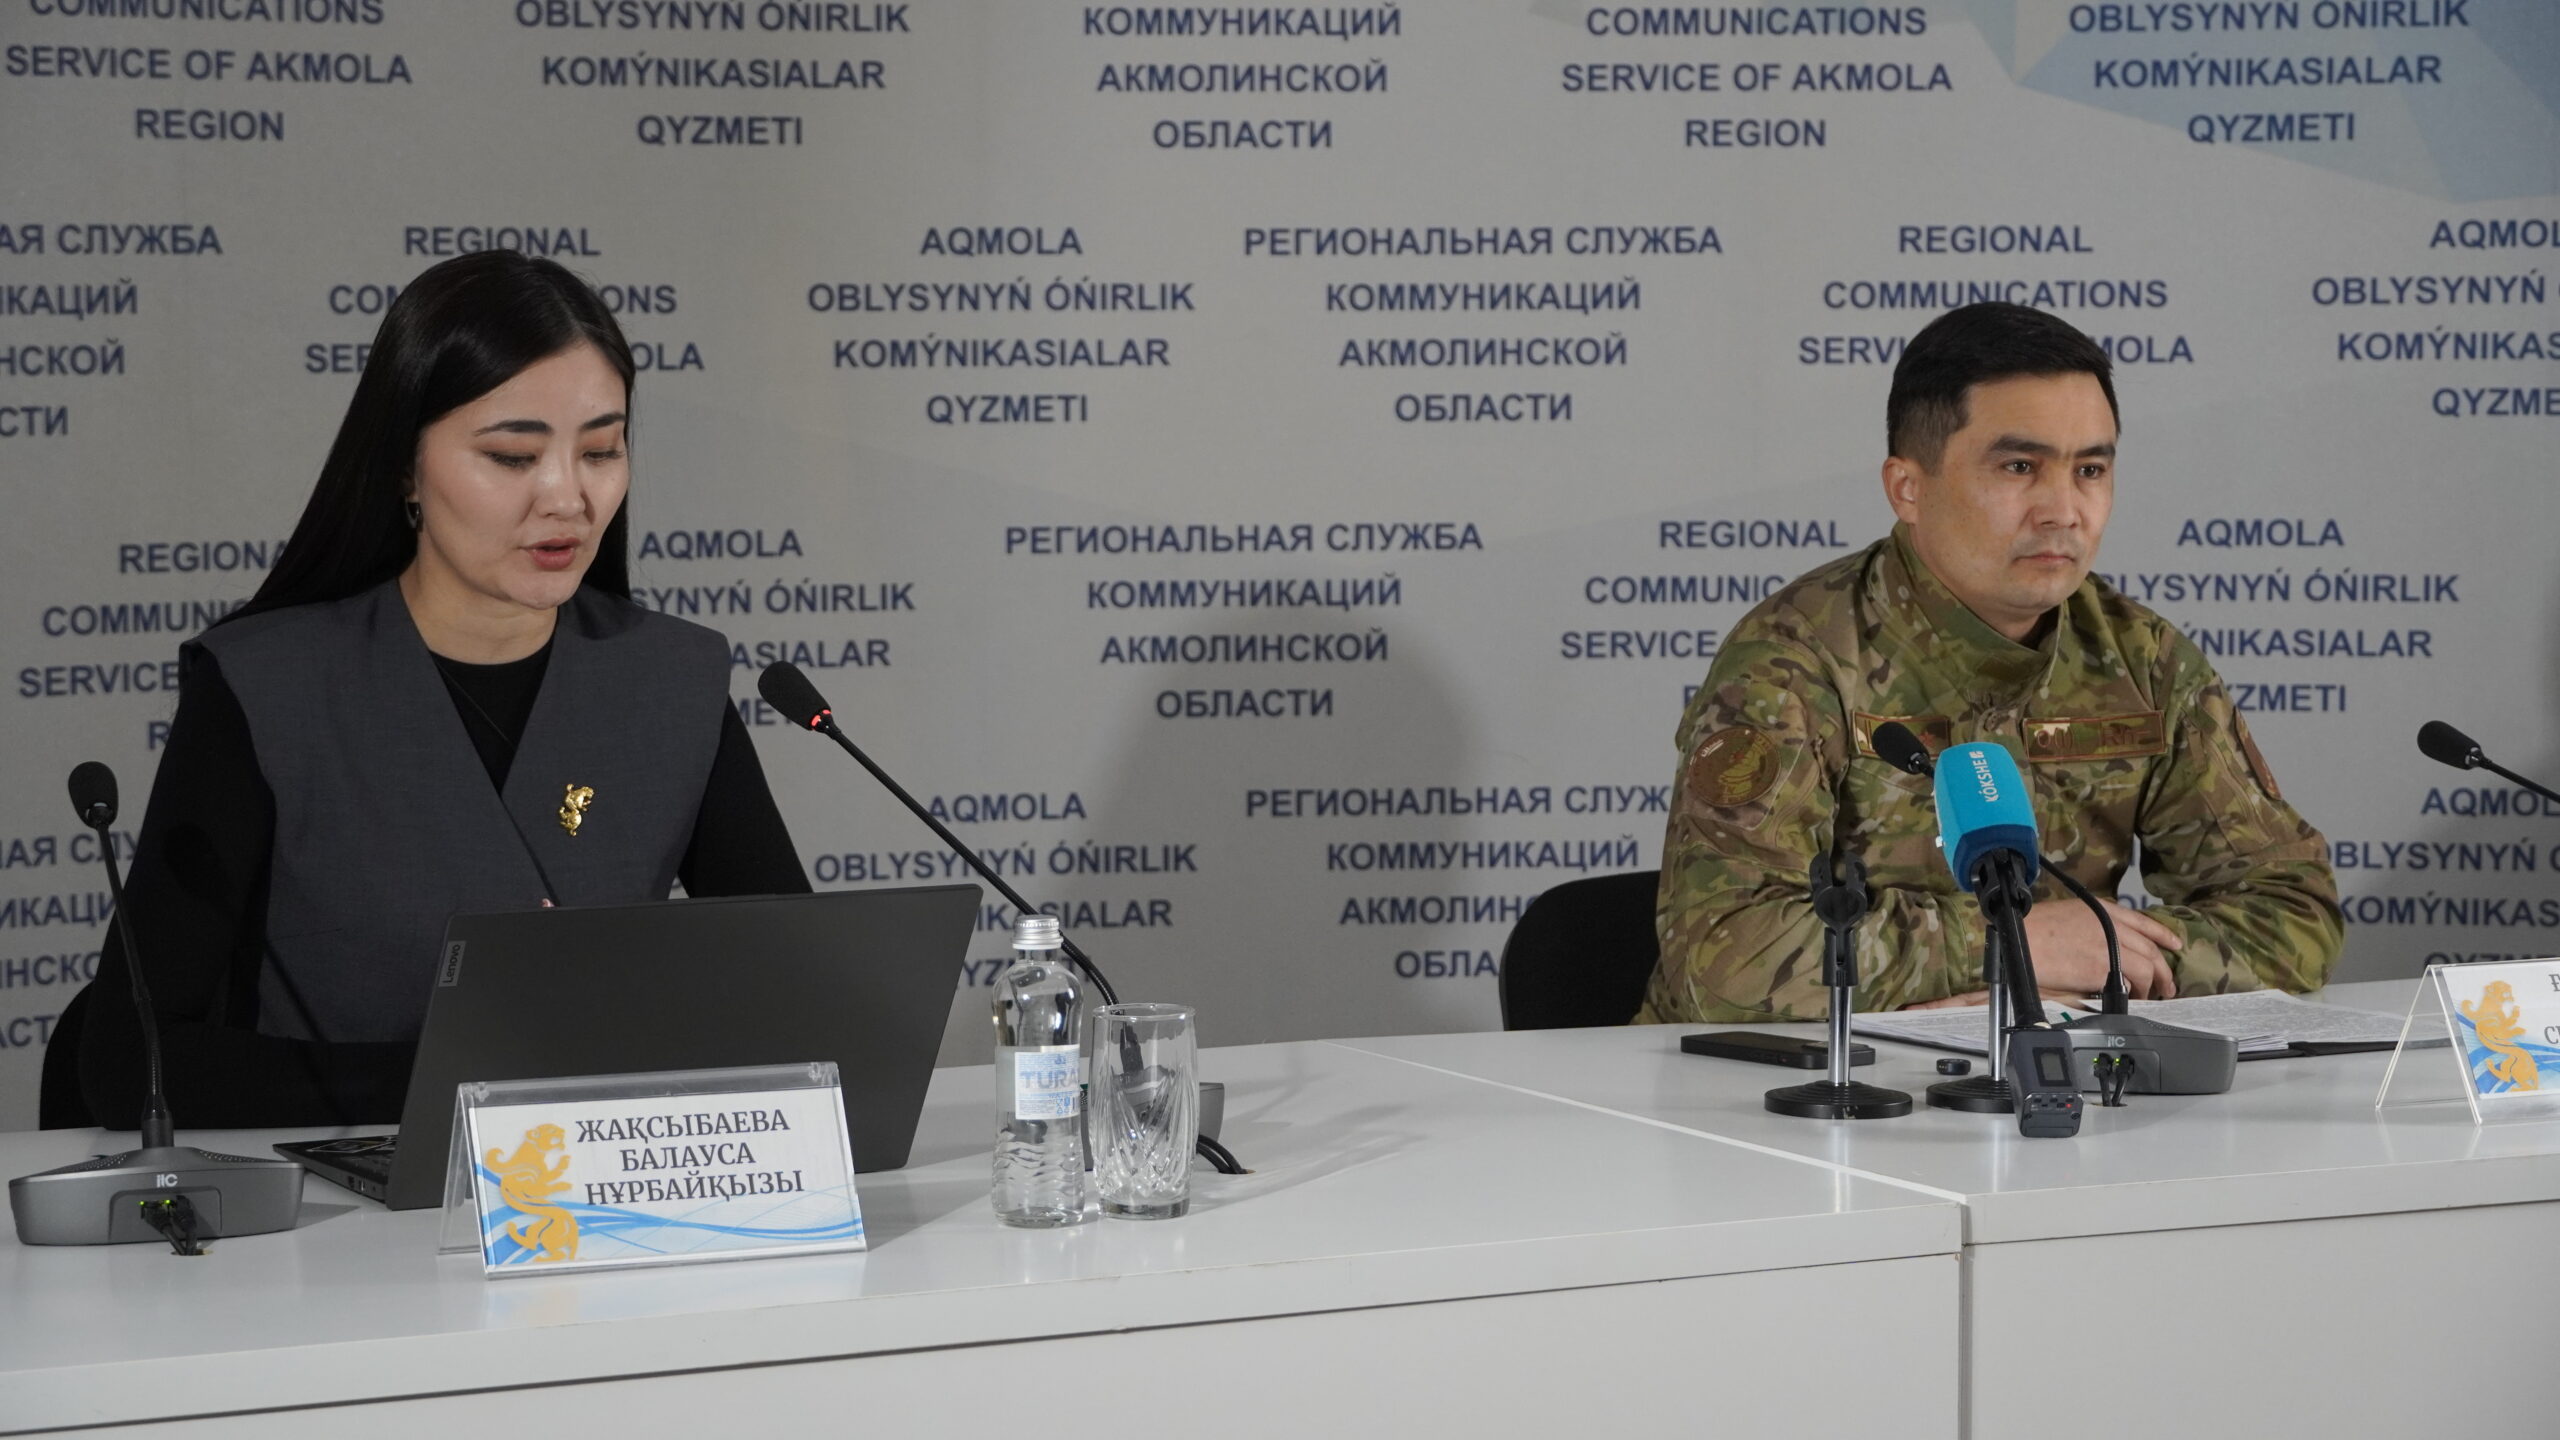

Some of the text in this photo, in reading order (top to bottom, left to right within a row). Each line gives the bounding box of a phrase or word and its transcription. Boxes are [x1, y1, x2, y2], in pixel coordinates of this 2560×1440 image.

[1085, 3, 1400, 41] КОММУНИКАЦИЙ
[1587, 7, 1926, 36] COMMUNICATIONS
[6, 45, 412, 84] SERVICE OF AKMOLA
[543, 51, 885, 89] KOMÝNIKASIALAR
[1097, 59, 1386, 92] АКМОЛИНСКОЙ
[1563, 63, 1952, 92] SERVICE OF AKMOLA
[2095, 52, 2441, 88] KOMÝNIKASIALAR
[136, 109, 283, 141] REGION
[637, 115, 802, 146] QYZMETI
[1153, 120, 1331, 149] ОБЛАСТИ
[1686, 119, 1825, 147] REGION
[2188, 113, 2354, 144] QYZMETI
[57, 224, 223, 254] СЛУЖБА
[920, 227, 1082, 256] AQMOLA
[1245, 227, 1722, 256] РЕГИОНАЛЬНАЯ СЛУЖБА
[1900, 225, 2093, 253] REGIONAL
[808, 277, 1194, 312] OBLYSYNYŃ ÓŃIRLIK
[1327, 277, 1640, 315] КОММУНИКАЦИЙ
[2312, 269, 2544, 305] OBLYSYNYŃ
[835, 333, 1169, 368] KOMÝNIKASIALAR
[1339, 333, 1626, 366] АКМОЛИНСКОЙ
[1800, 336, 1906, 365] SERVI
[927, 395, 1087, 424] QYZMETI
[1395, 394, 1571, 422] ОБЛАСТИ
[638, 529, 803, 560] AQMOLA
[1006, 523, 1483, 554] РЕГИОНАЛЬНАЯ СЛУЖБА
[1660, 521, 1848, 548] REGIONAL
[2177, 519, 2344, 548] AQMOLA
[765, 578, 915, 614] ÓŃIRLIK
[1088, 573, 1400, 612] КОММУНИКАЦИЙ
[2304, 568, 2459, 602] ÓŃIRLIK
[1100, 628, 1387, 663] АКМОЛИНСКОЙ
[1560, 628, 1719, 659] SERVICE
[1156, 689, 1333, 719] ОБЛАСТИ
[929, 793, 1088, 823] AQMOLA
[1246, 785, 1670, 817] РЕГИОНАЛЬНАЯ СЛУЖ
[1049, 840, 1197, 875] ÓŃIRLIK
[1328, 835, 1638, 873] КОММУНИКАЦИЙ
[2327, 836, 2537, 872] BLYSYNYŃ
[442, 944, 461, 984] Lenovo
[1394, 949, 1500, 980] ОБЛА
[576, 1109, 790, 1144] ЖАҚСЫБАЕВА
[620, 1142, 756, 1171] БАЛАУСА
[585, 1170, 804, 1206] НҰРБАЙҚЫЗЫ
